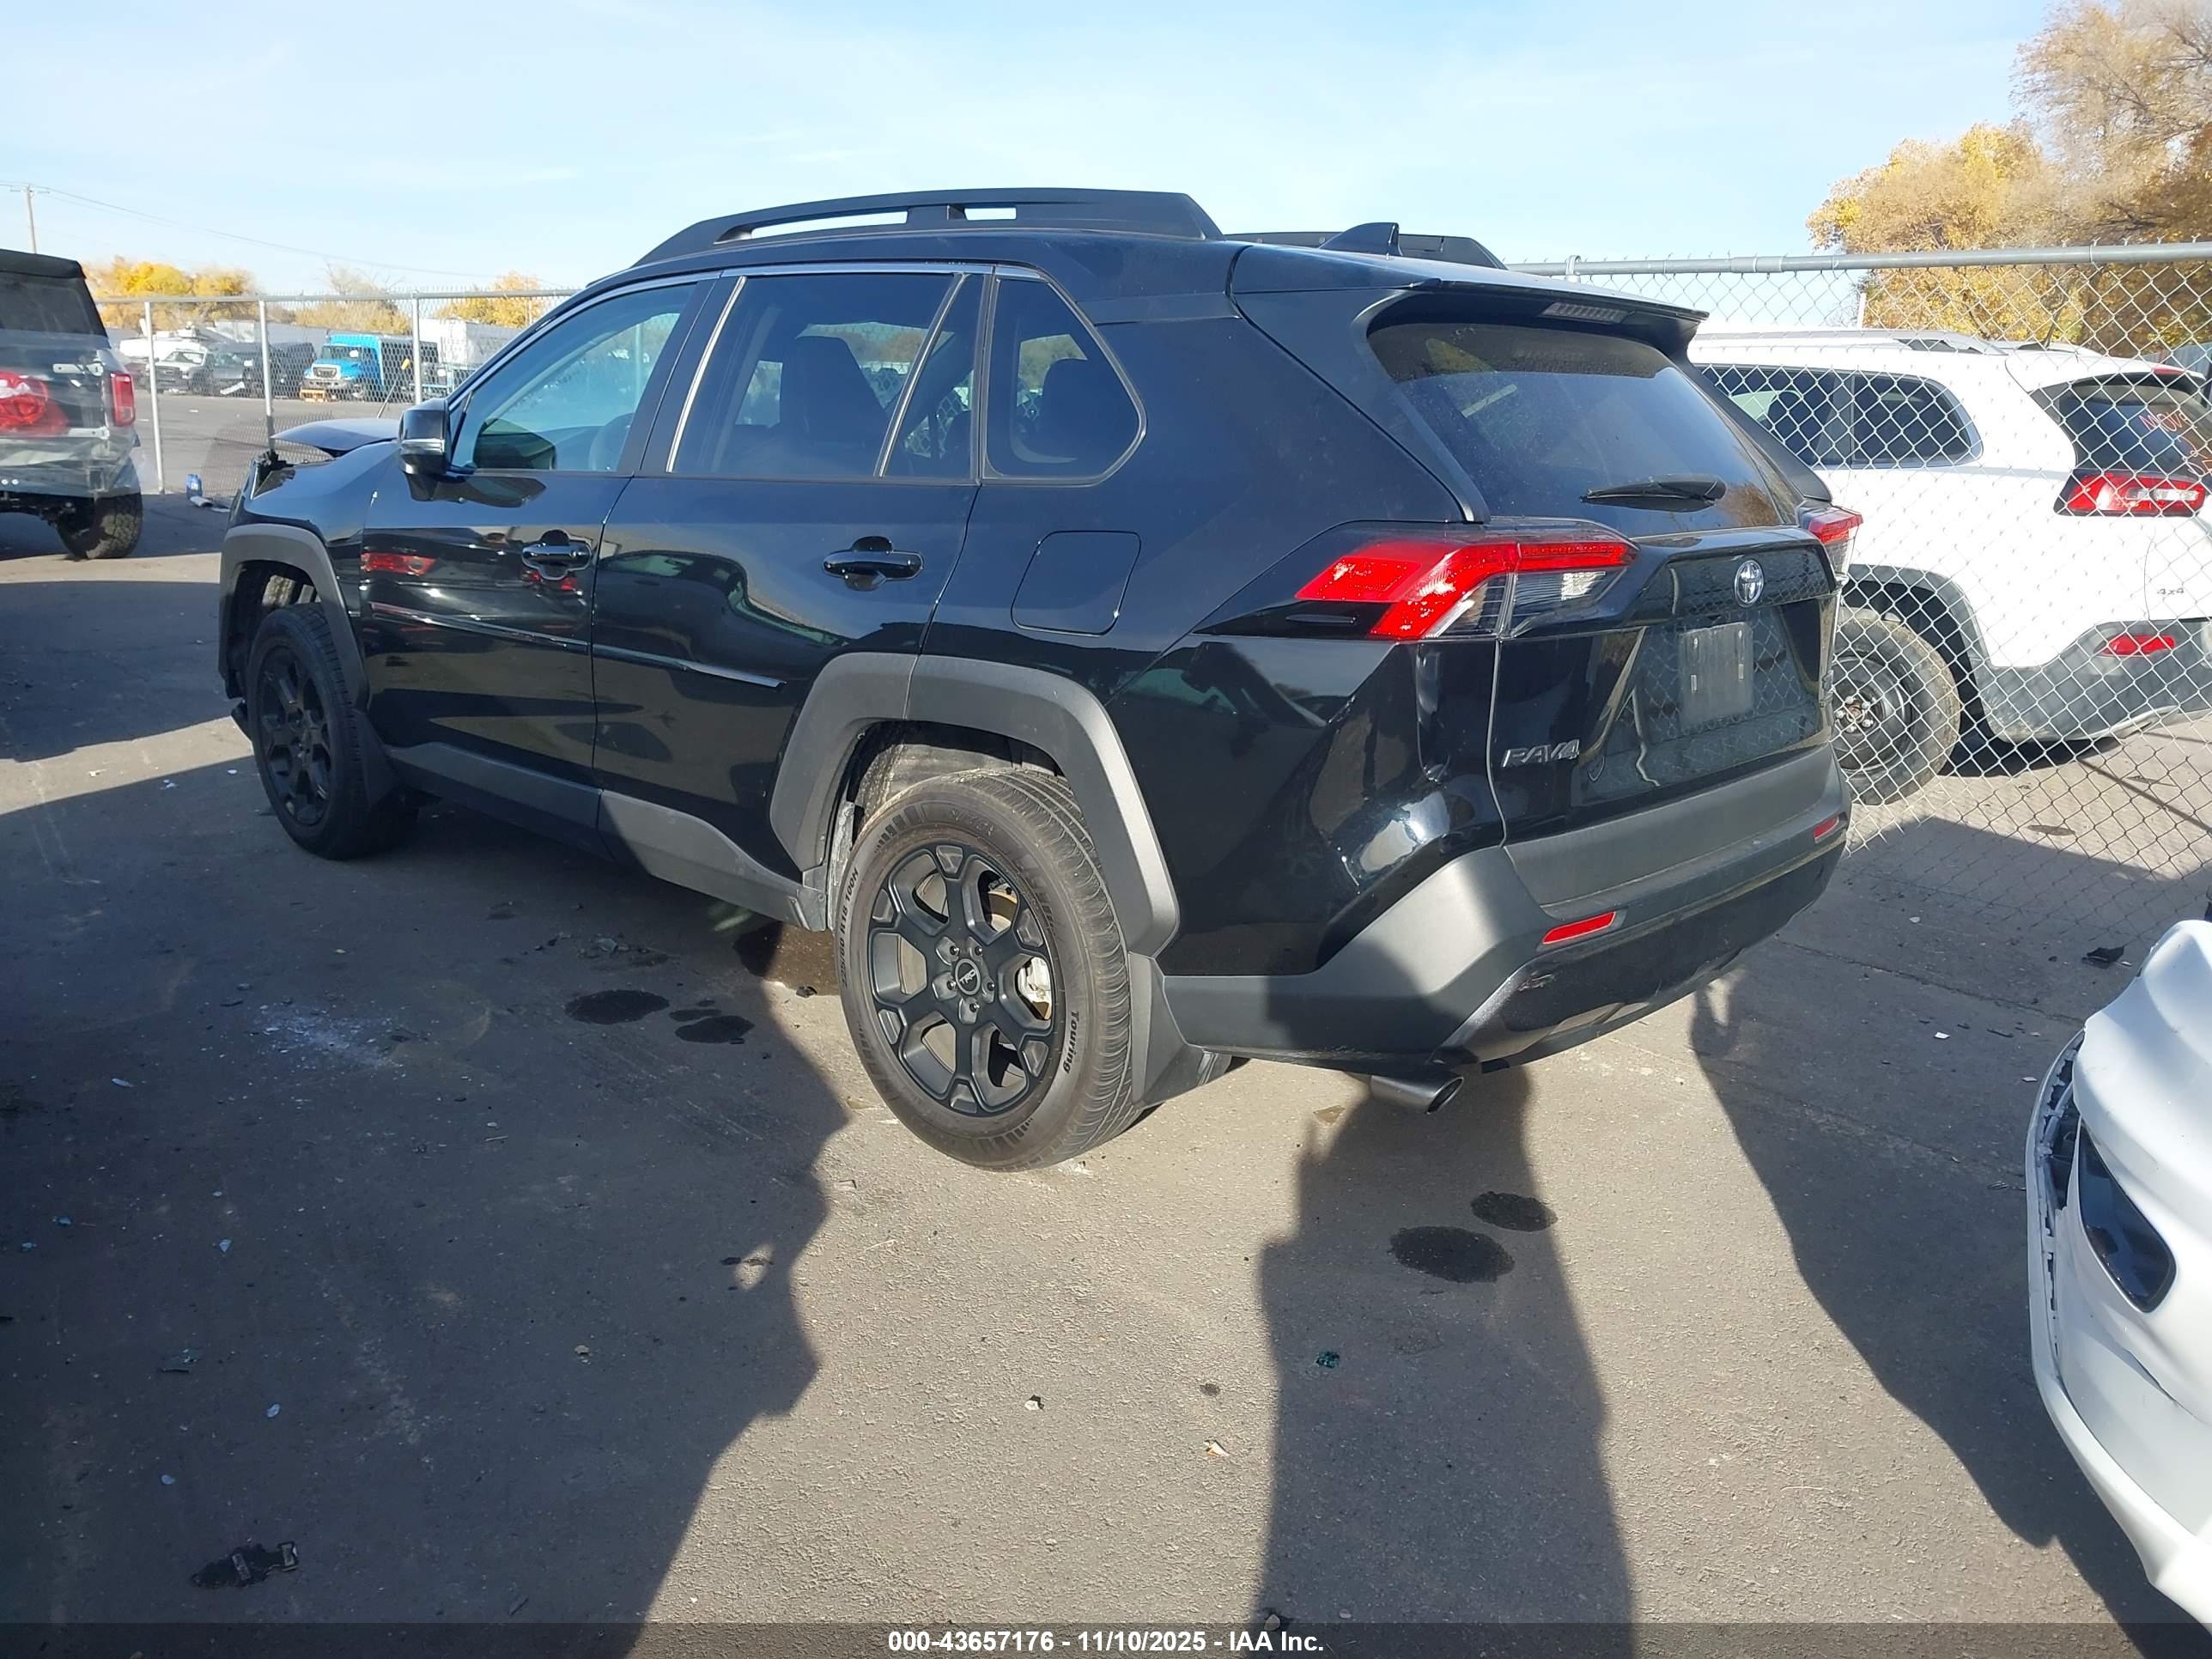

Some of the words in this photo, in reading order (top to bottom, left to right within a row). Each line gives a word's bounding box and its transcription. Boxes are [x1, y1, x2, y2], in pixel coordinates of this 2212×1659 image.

[2157, 587, 2185, 596] 4x4
[1500, 739, 1580, 769] RAV4
[845, 867, 859, 902] 100H
[959, 969, 976, 984] TRD
[1062, 1011, 1079, 1074] Touring
